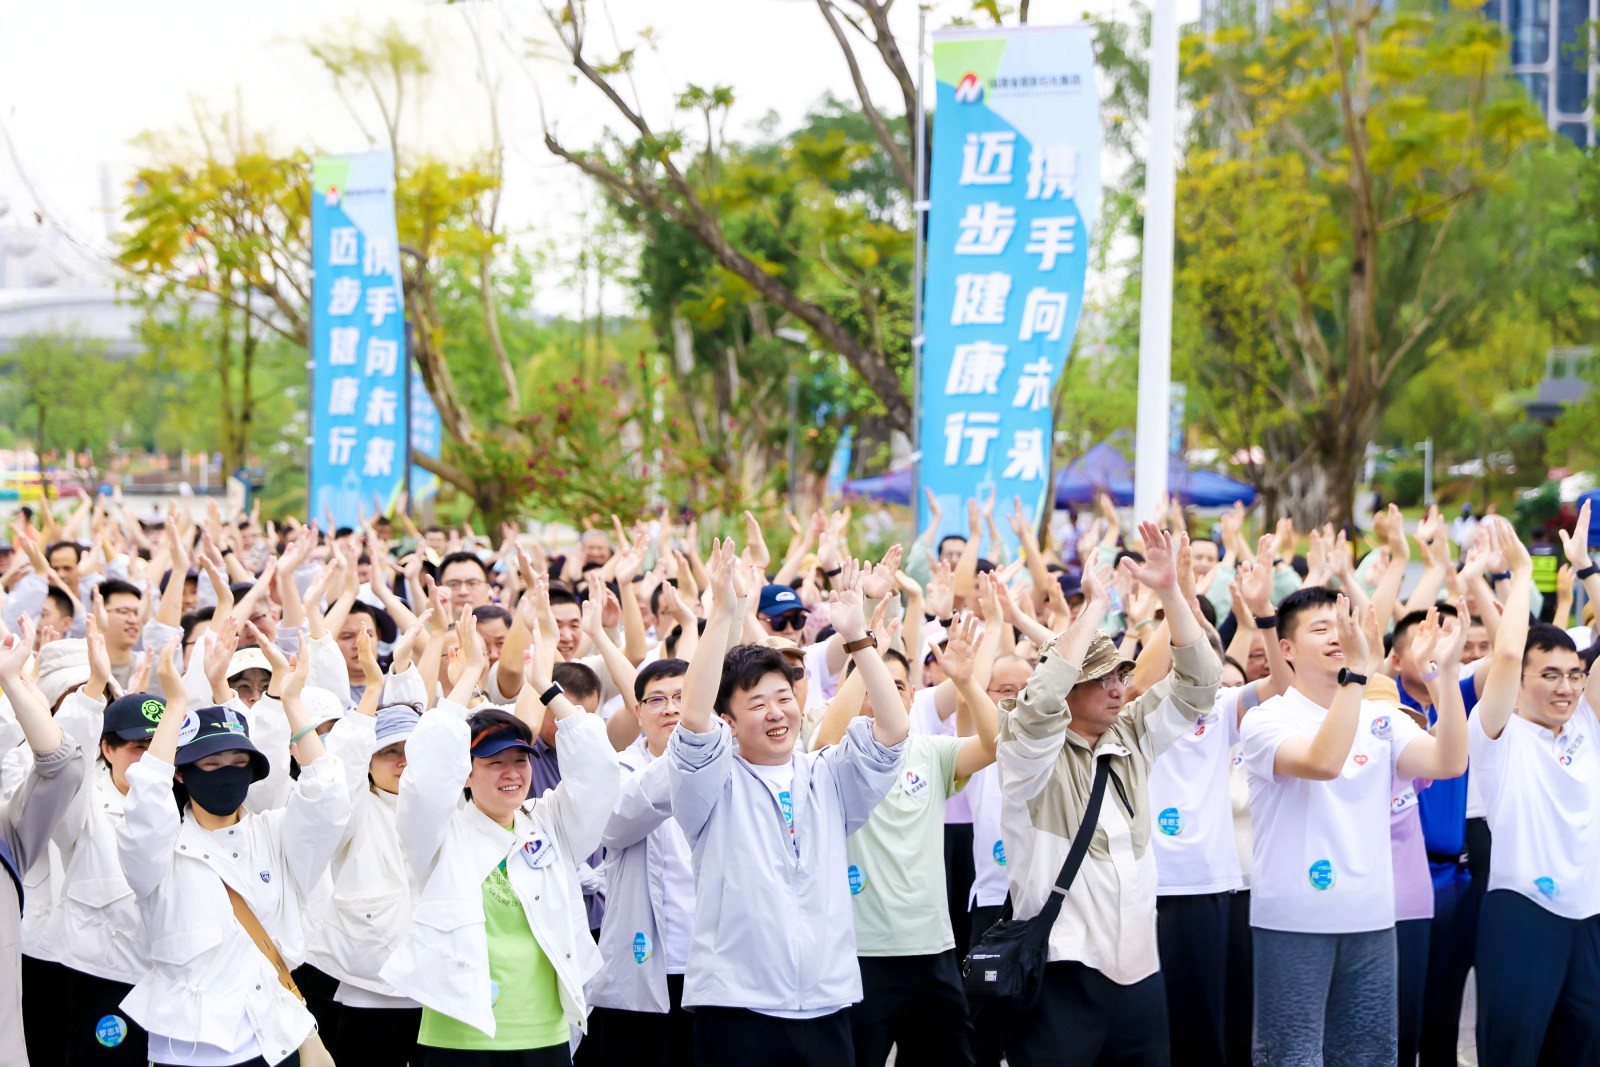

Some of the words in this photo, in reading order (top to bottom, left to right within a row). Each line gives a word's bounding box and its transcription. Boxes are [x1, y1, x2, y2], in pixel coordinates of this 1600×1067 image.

[943, 131, 1017, 466] 迈步健康行
[488, 887, 510, 907] NATURE
